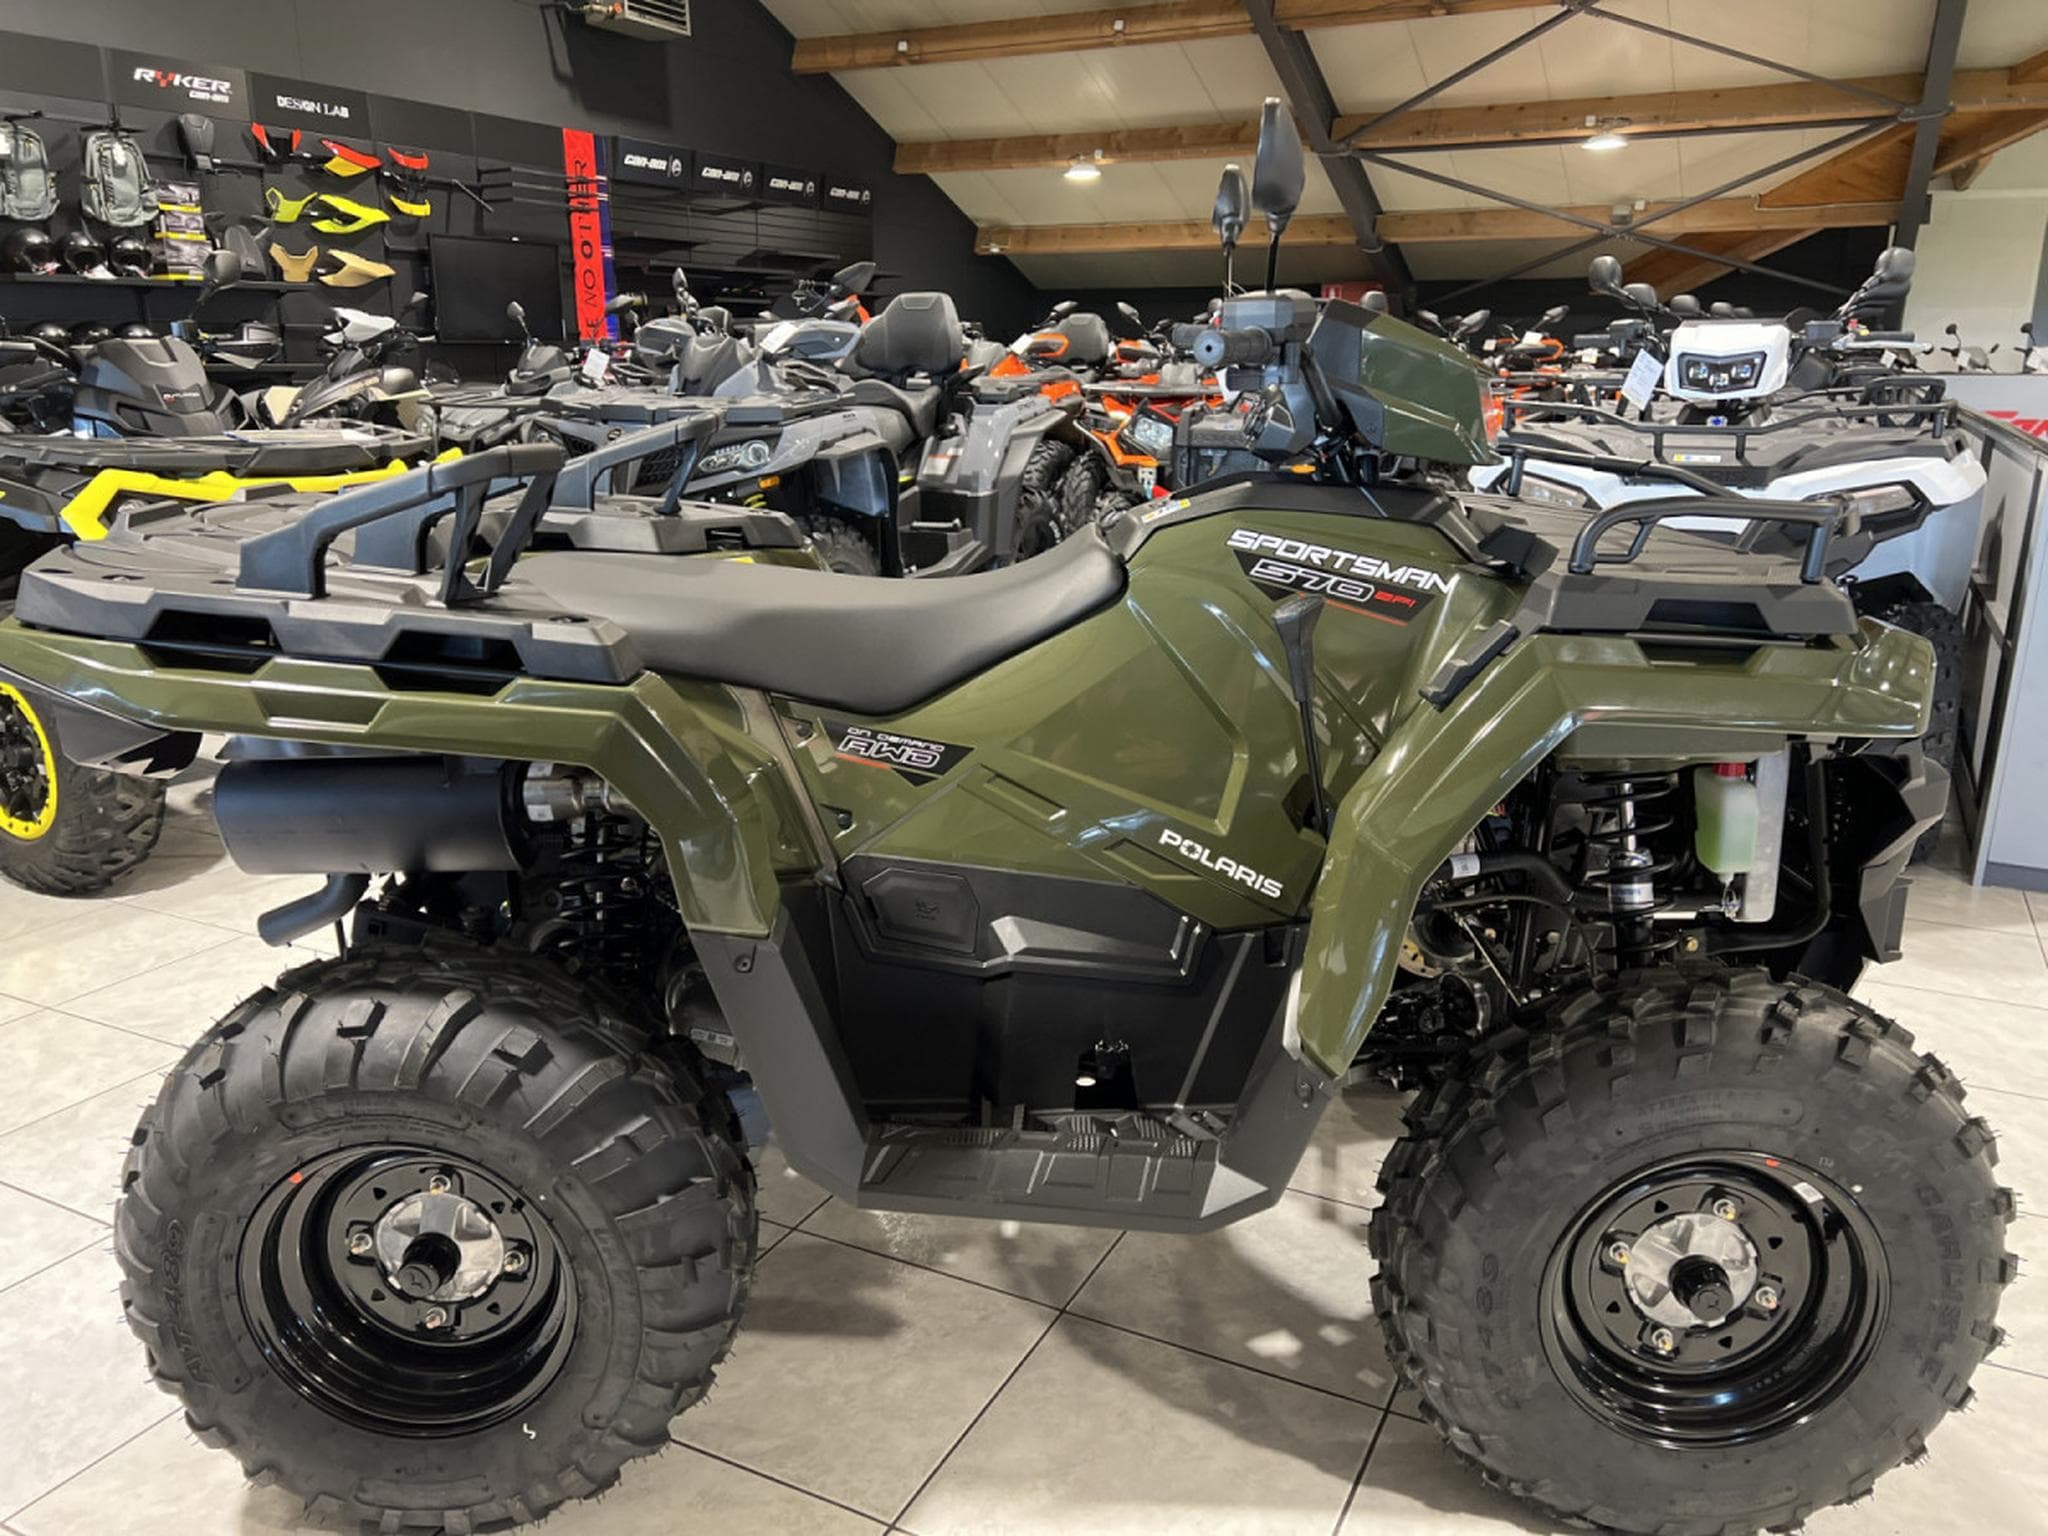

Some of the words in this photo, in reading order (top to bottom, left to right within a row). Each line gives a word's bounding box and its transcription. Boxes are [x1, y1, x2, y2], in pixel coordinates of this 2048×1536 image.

[133, 68, 231, 94] RYKER
[276, 95, 321, 114] DESIGN
[323, 103, 349, 118] LAB
[1226, 528, 1459, 594] SPORTSMAN
[1250, 558, 1375, 602] 570
[837, 734, 941, 769] AWD
[1158, 828, 1284, 899] POLARIS
